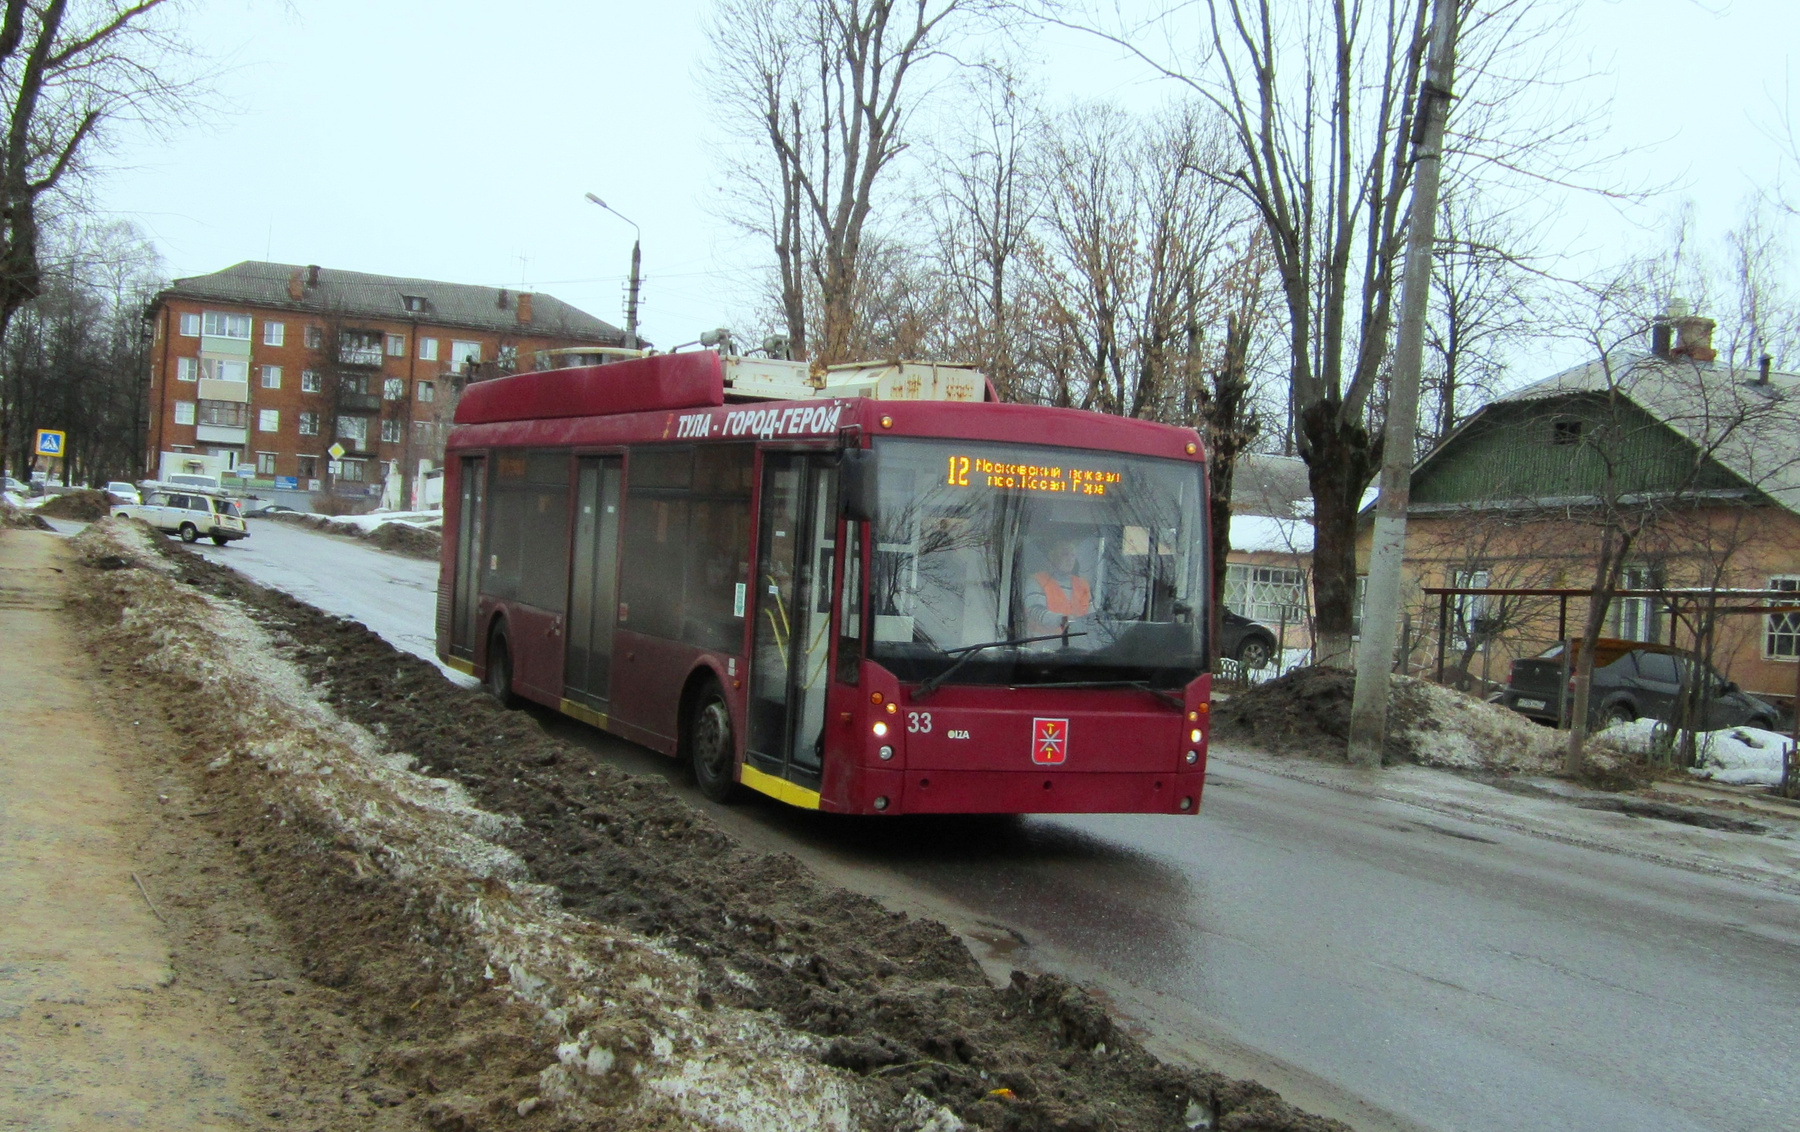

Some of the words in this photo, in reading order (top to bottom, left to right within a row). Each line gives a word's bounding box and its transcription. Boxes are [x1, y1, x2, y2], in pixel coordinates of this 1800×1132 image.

[676, 413, 712, 438] ТУЛА
[722, 399, 842, 440] ГОРОД-ГЕРОЙ
[947, 455, 971, 487] 12
[907, 711, 932, 733] 33
